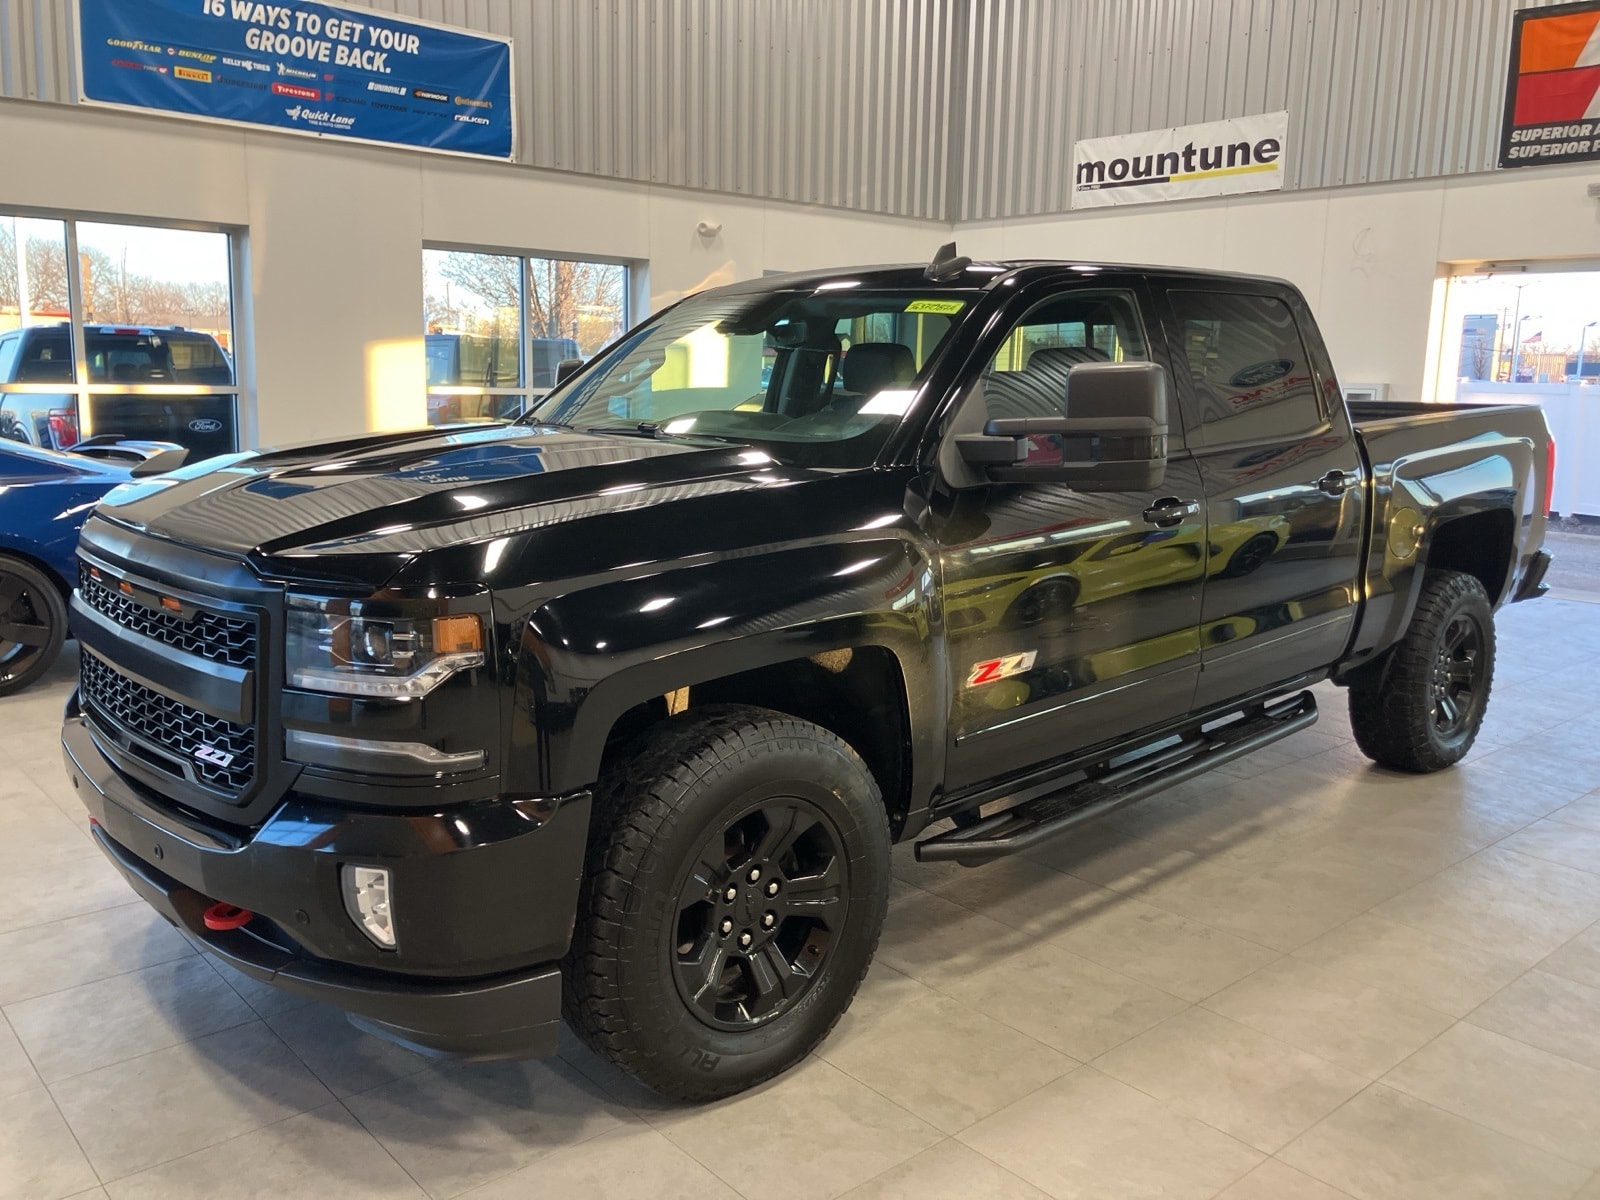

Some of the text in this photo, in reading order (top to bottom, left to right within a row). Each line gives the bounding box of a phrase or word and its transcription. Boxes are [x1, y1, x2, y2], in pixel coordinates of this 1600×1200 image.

[202, 0, 420, 55] 16 WAYS TO GET YOUR
[107, 38, 162, 54] GOODYEAR
[245, 28, 391, 74] GROOVE BACK.
[178, 50, 217, 62] DUNLOP
[285, 67, 318, 79] MICHELIN
[277, 85, 316, 98] Firestone
[301, 108, 355, 125] Quick Lane
[454, 114, 490, 126] FALKEN
[1510, 124, 1593, 143] SUPERIOR
[1508, 140, 1591, 159] SUPERIOR
[1076, 138, 1281, 184] mountune
[966, 650, 1038, 688] Z71
